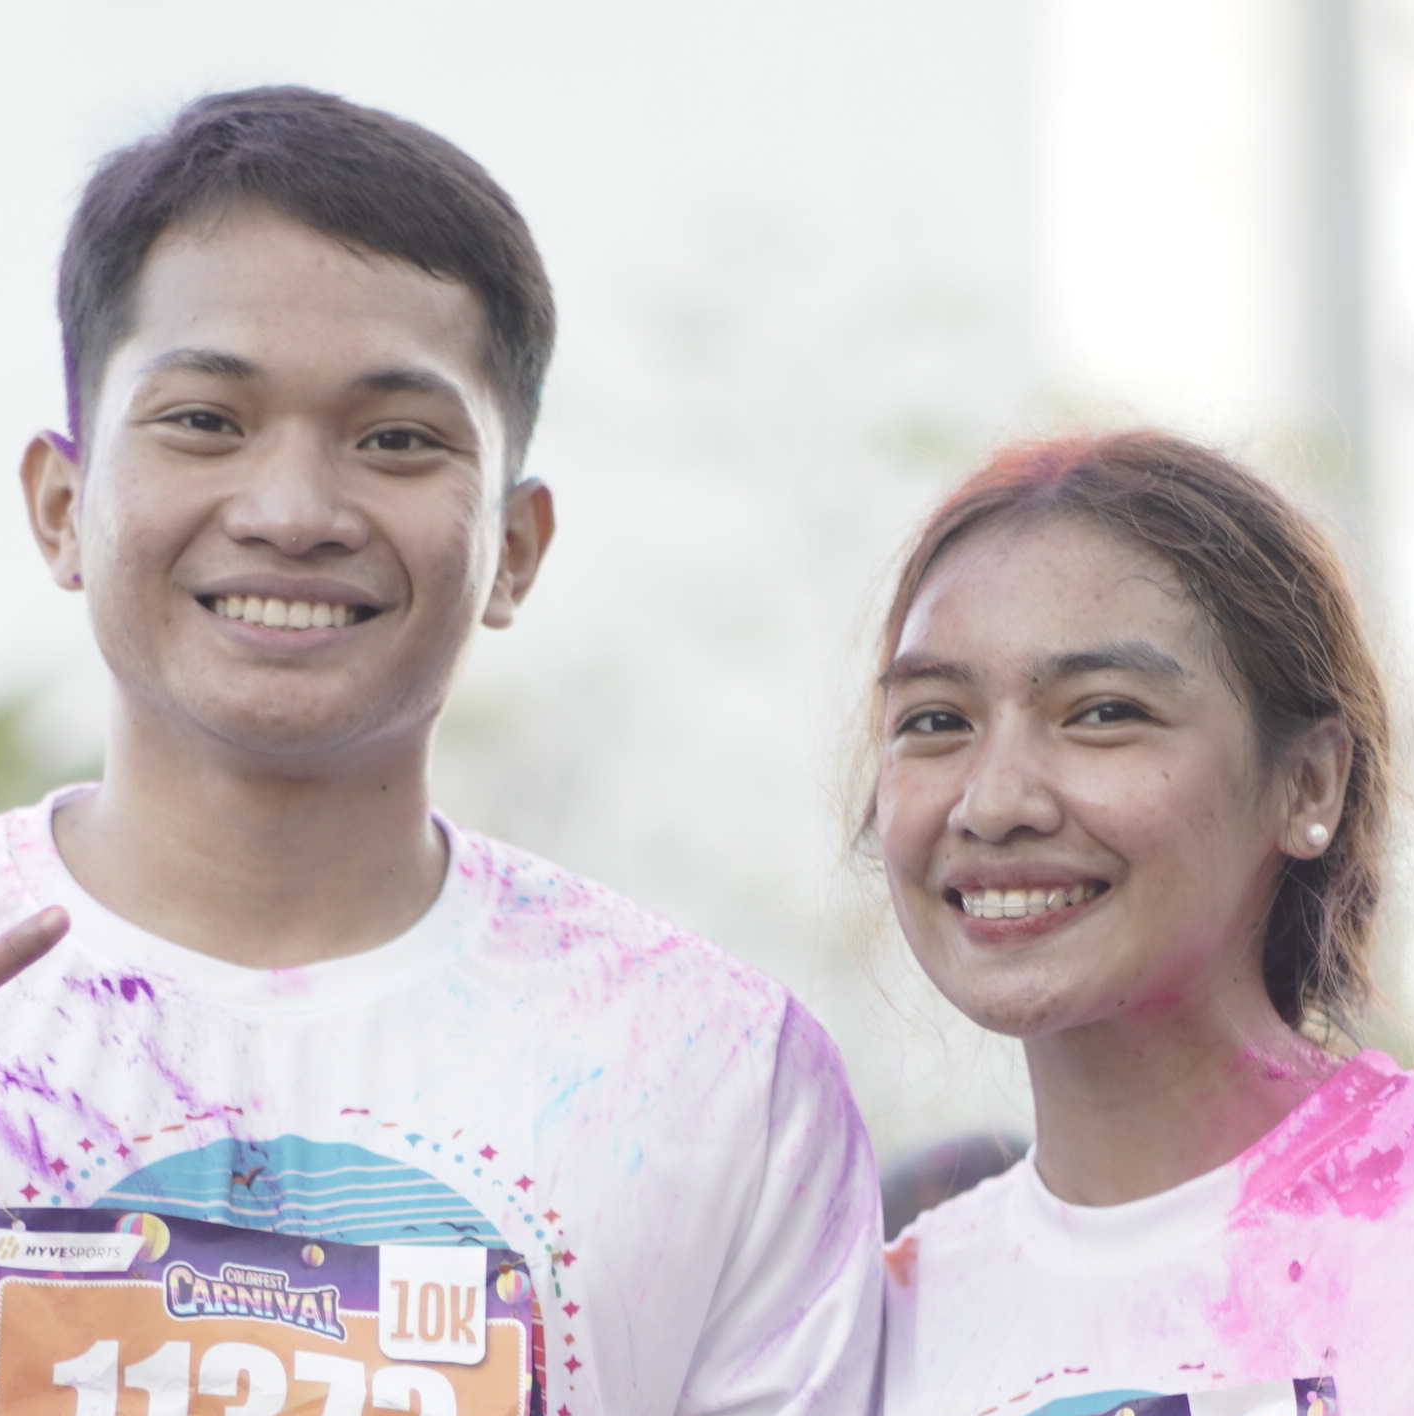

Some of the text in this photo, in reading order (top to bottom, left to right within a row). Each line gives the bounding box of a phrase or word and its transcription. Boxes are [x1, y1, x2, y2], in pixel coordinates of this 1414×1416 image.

[25, 1244, 121, 1260] HYVESPORTS
[224, 1267, 285, 1288] COLORFEST
[169, 1266, 342, 1336] CARNIVAL
[389, 1279, 477, 1344] 10K
